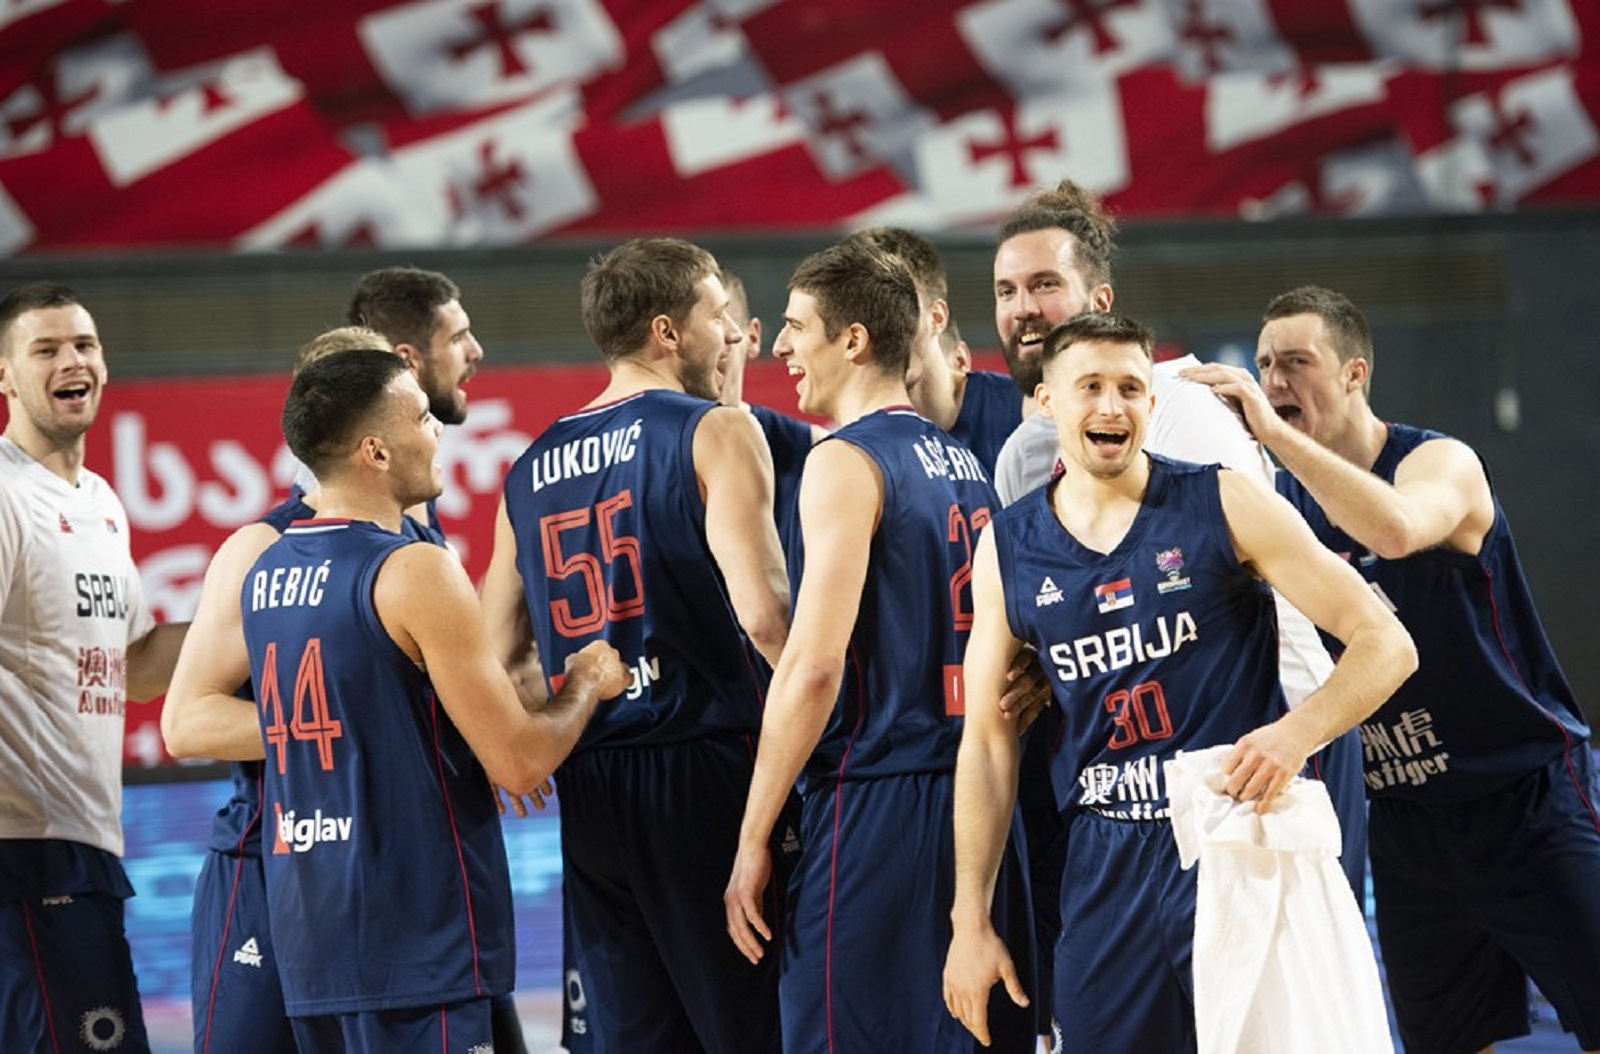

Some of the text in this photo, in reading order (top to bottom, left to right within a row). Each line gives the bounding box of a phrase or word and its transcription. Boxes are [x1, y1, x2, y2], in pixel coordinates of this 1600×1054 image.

[532, 419, 643, 493] LUKOVIĆ
[252, 560, 331, 612] REBIĆ
[540, 488, 645, 638] 55
[948, 503, 993, 631] 2
[1049, 611, 1199, 682] SRBIJA
[260, 638, 342, 775] 44
[1104, 680, 1174, 750] 30
[1358, 708, 1444, 763] 洲虎
[1077, 753, 1169, 806] 澳洲
[1362, 752, 1450, 791] stiger
